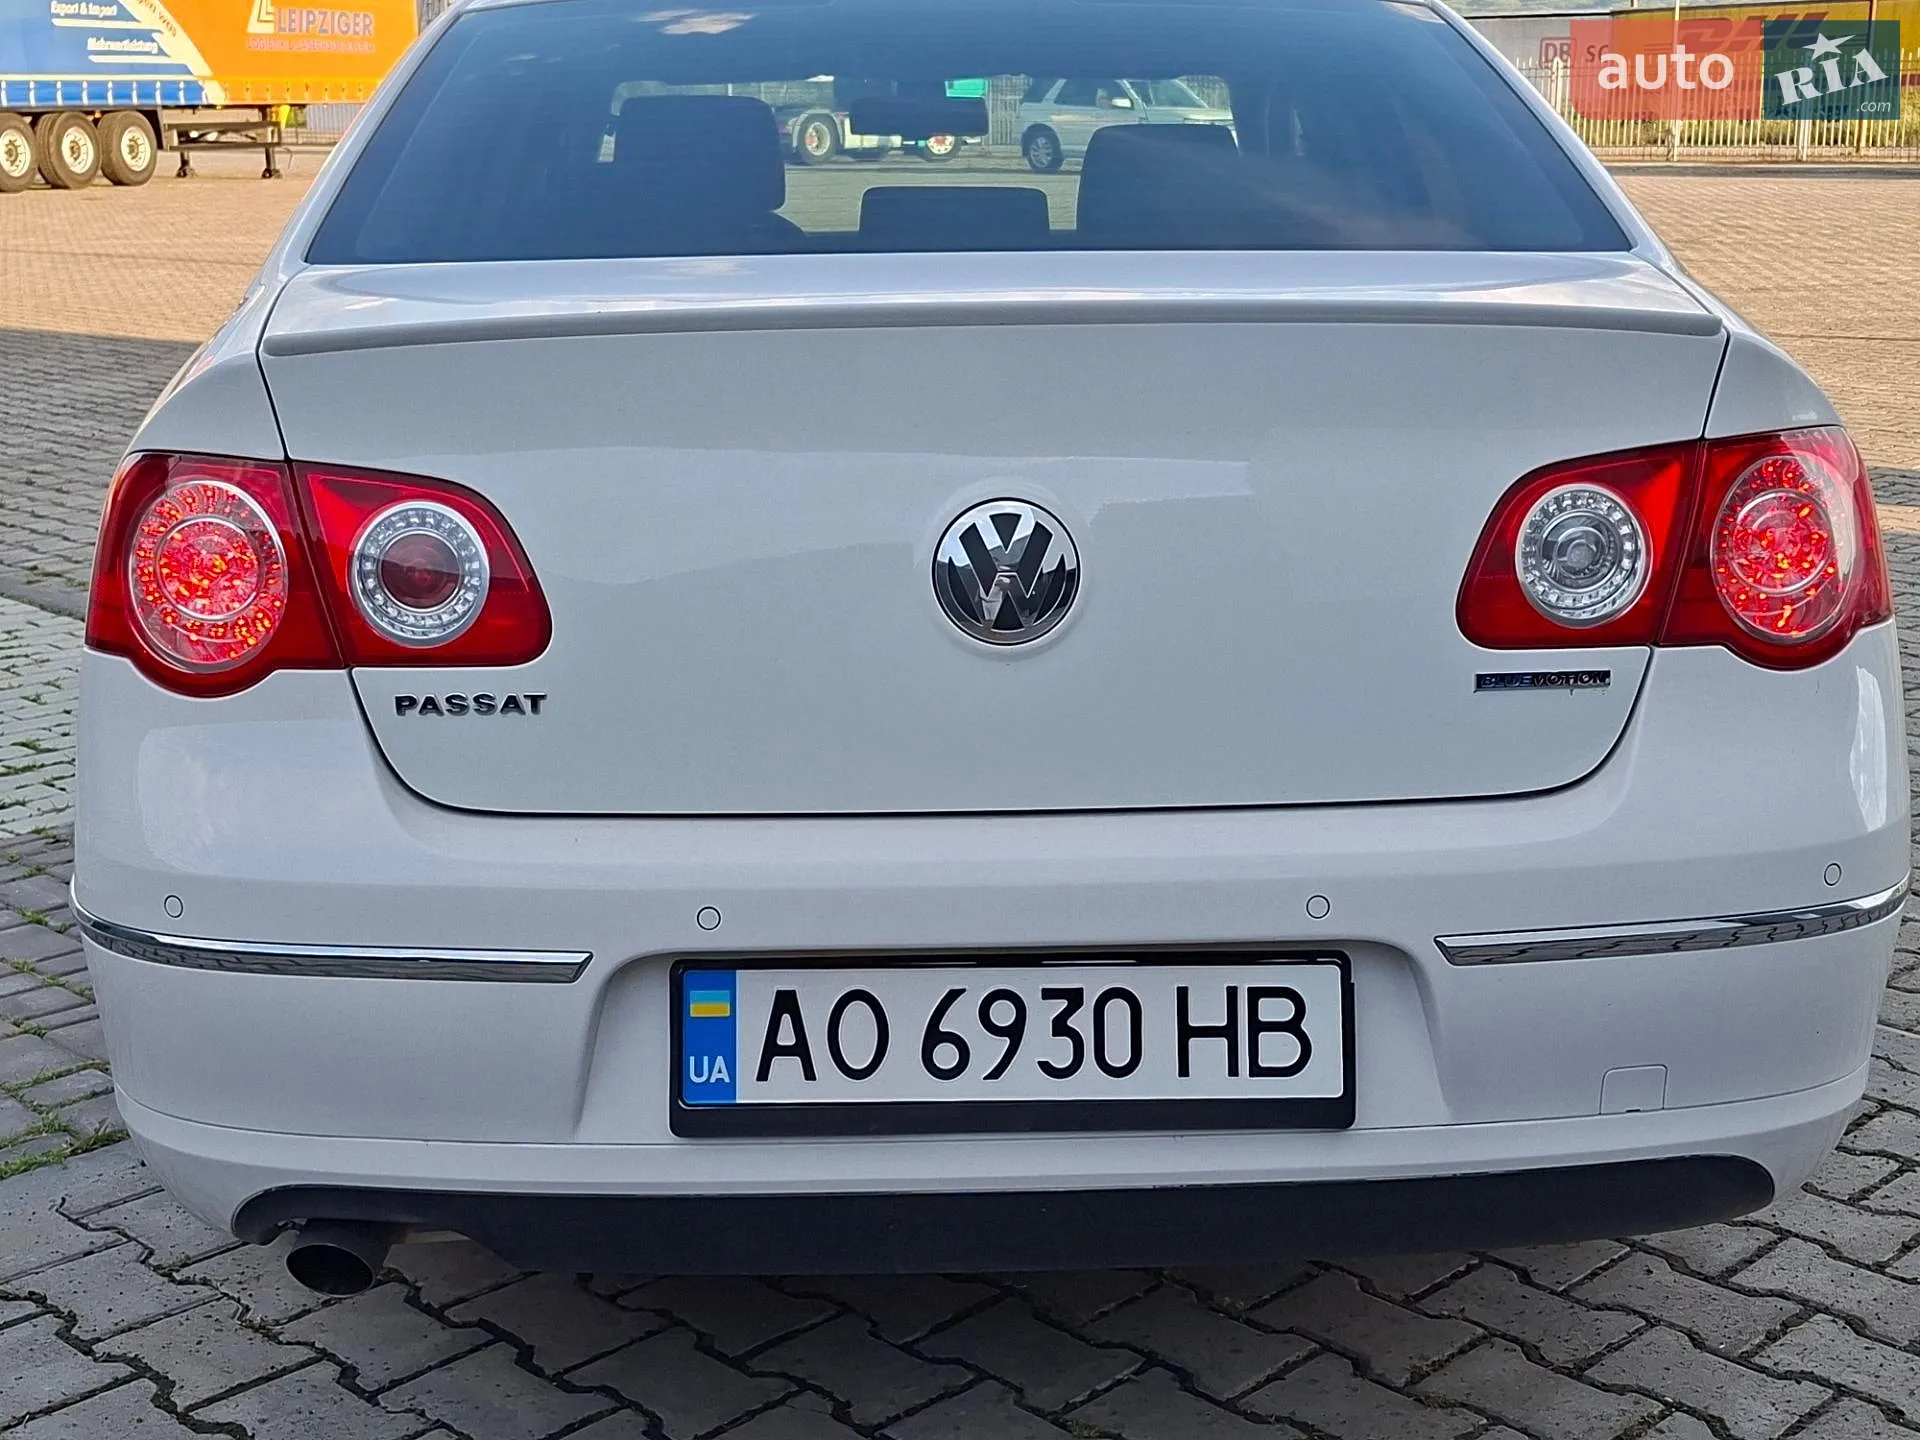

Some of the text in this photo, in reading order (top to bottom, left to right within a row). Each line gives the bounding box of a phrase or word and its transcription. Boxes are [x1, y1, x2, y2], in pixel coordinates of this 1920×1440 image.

[277, 9, 373, 36] LEIPZIGER
[394, 692, 547, 717] PASSAT
[755, 984, 1313, 1082] AO 6930 HB
[688, 1057, 730, 1084] UA
